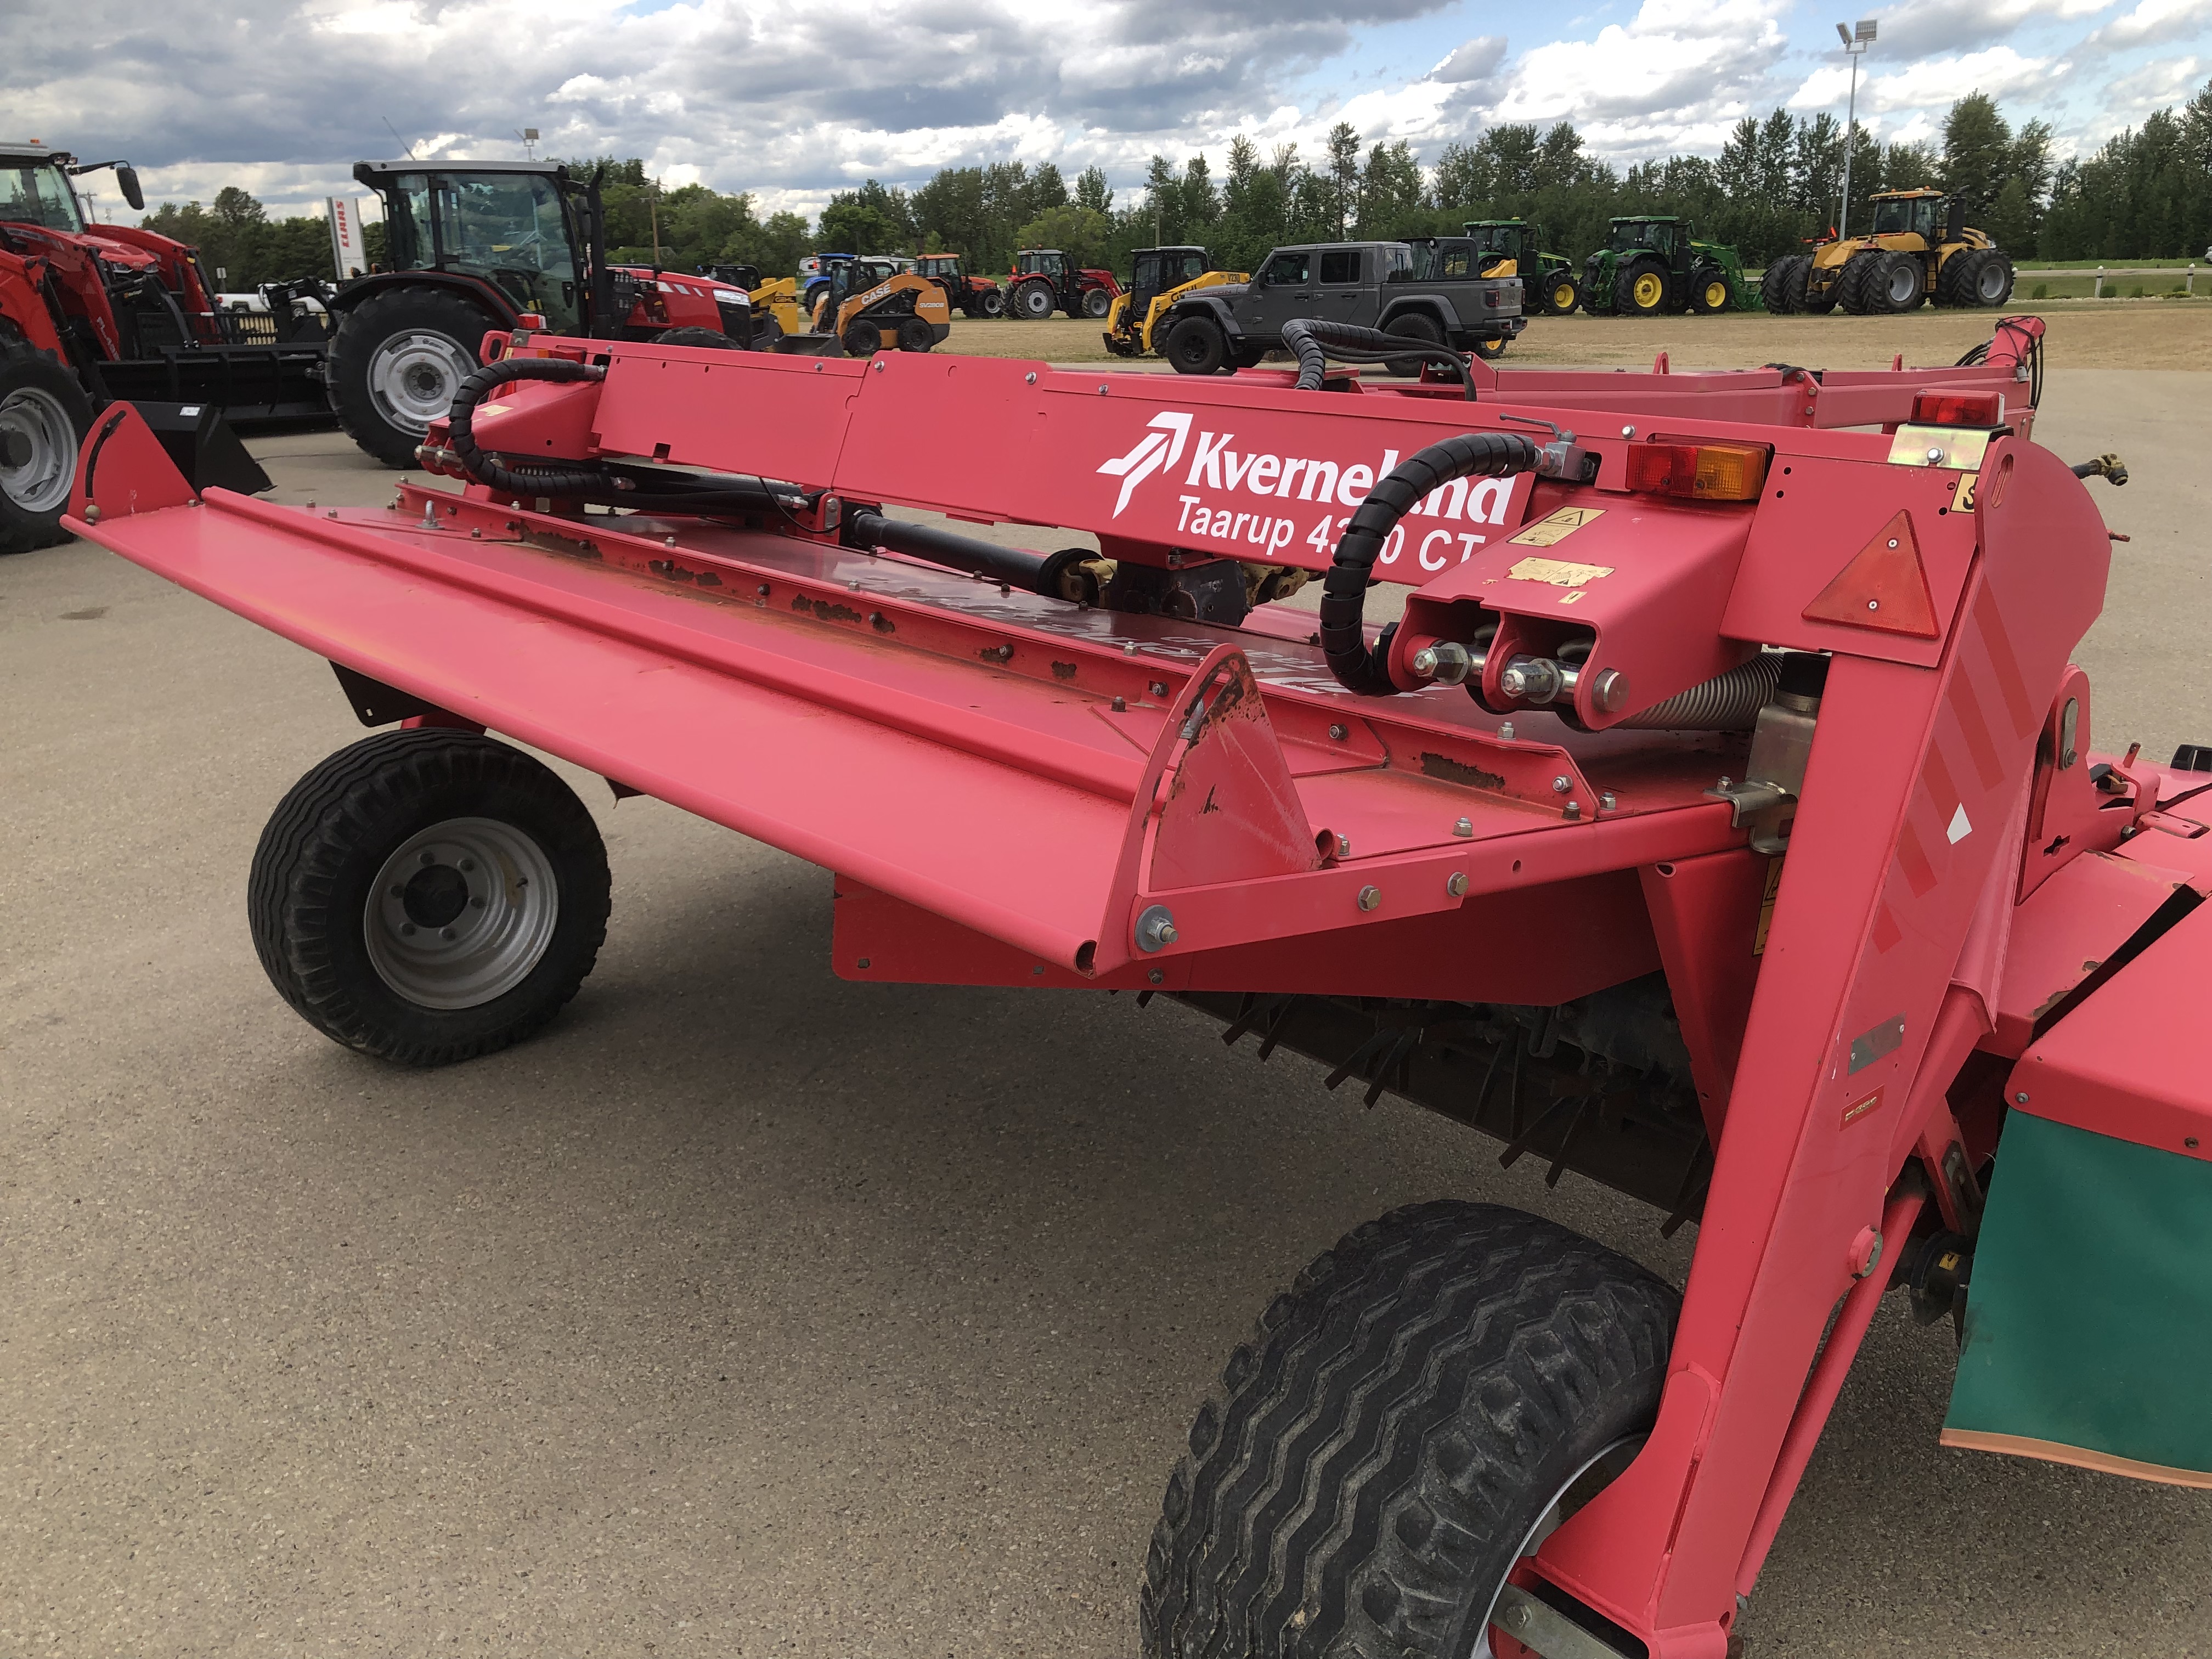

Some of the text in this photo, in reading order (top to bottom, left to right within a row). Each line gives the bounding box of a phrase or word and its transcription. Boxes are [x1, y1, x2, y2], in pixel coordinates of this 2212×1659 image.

[861, 283, 891, 305] CASE
[1184, 430, 1517, 526] Kvernelnd
[1177, 494, 1486, 572] Taarup 430 CT
